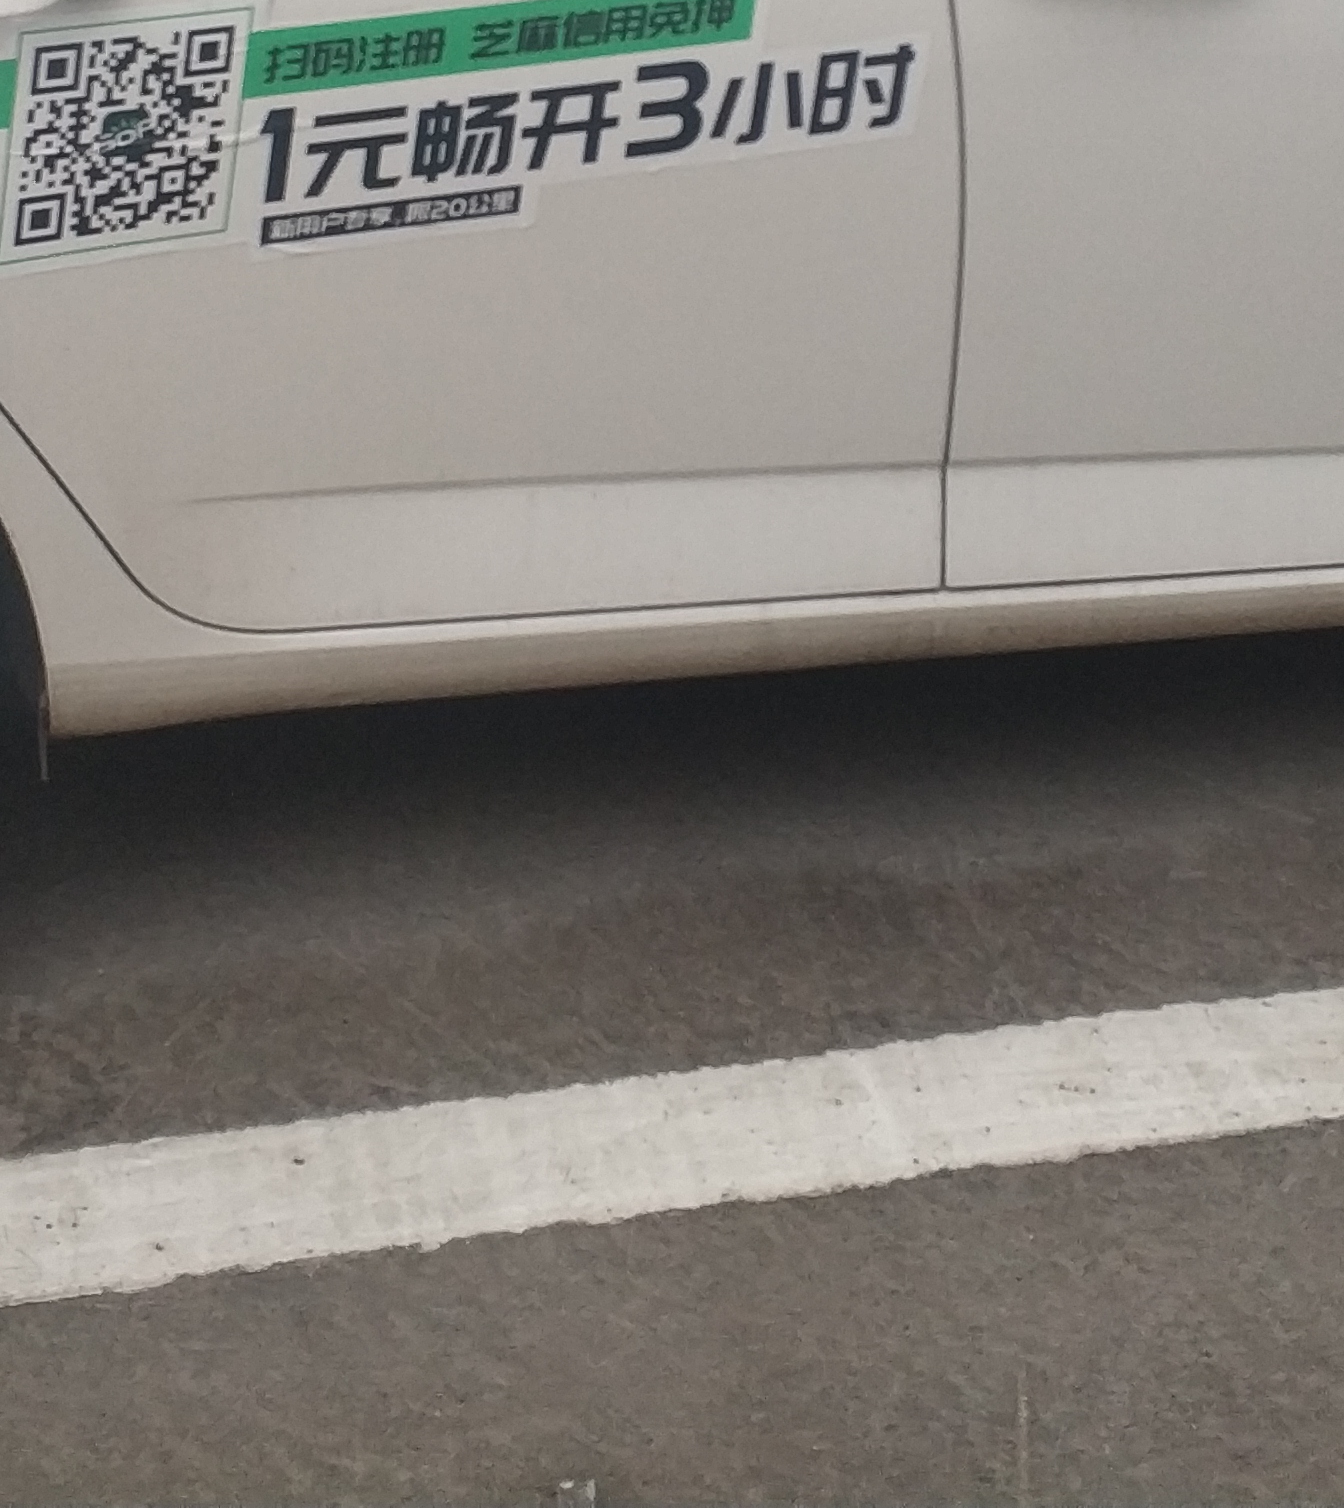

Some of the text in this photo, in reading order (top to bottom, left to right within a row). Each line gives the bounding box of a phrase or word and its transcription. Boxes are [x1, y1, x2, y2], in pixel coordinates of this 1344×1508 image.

[263, 26, 448, 85] 扫码注册
[261, 43, 916, 203] 1元畅开3小时
